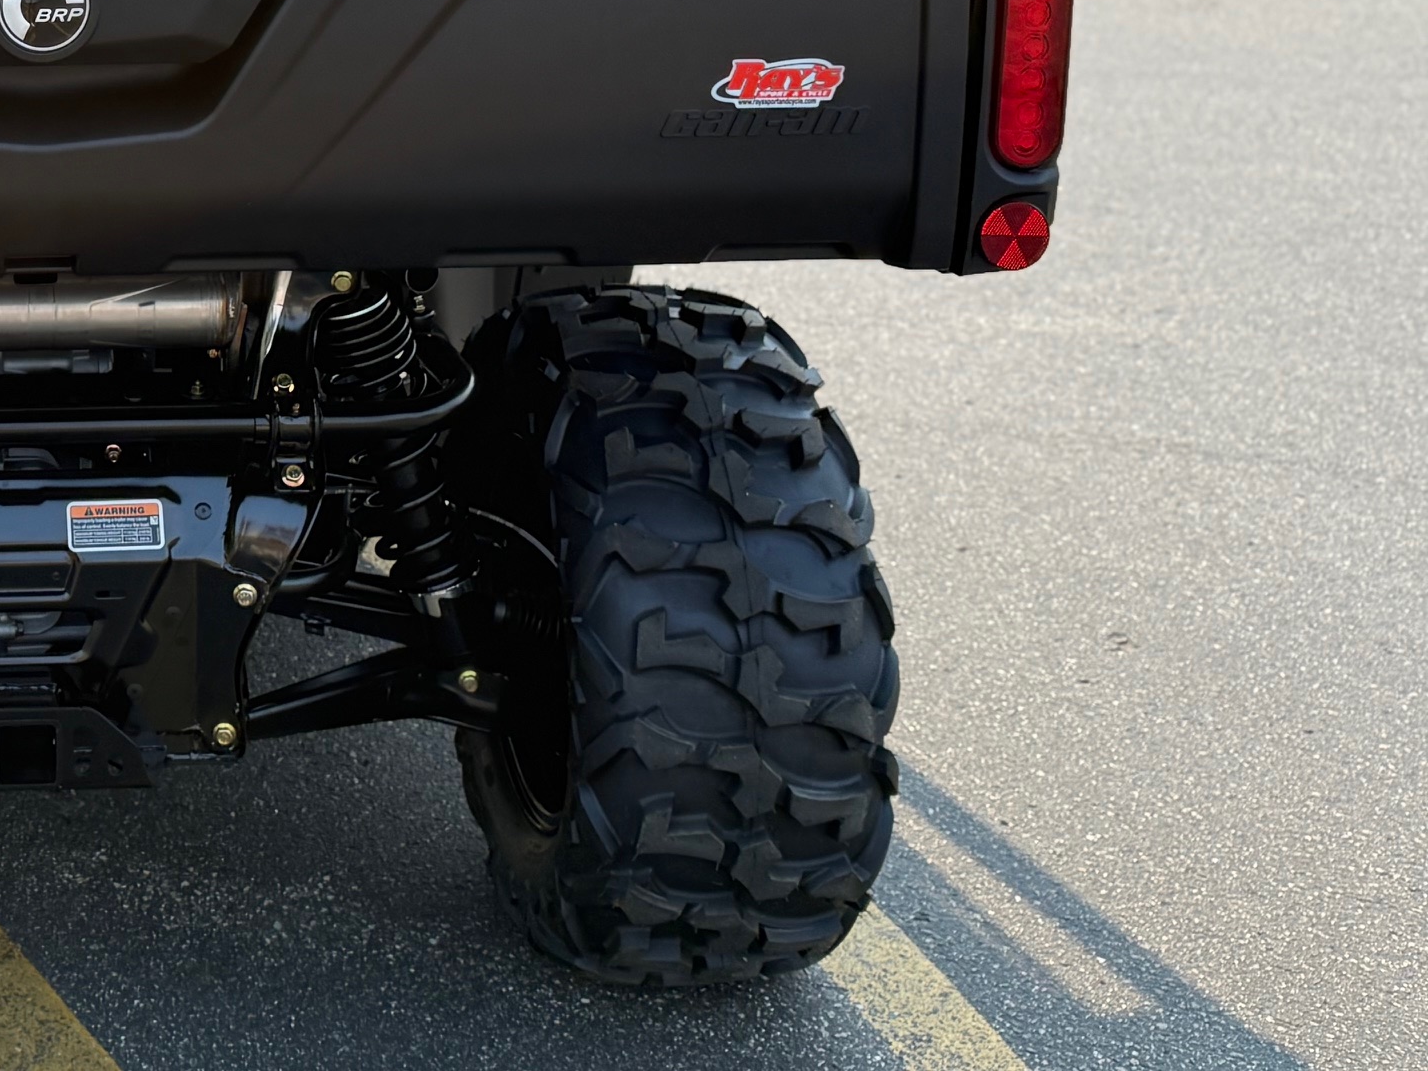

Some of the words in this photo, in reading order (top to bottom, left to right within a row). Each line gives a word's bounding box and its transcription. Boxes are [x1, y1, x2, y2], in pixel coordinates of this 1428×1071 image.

[35, 8, 84, 23] BRP
[759, 90, 786, 98] SPORT
[95, 507, 145, 516] WARNING
